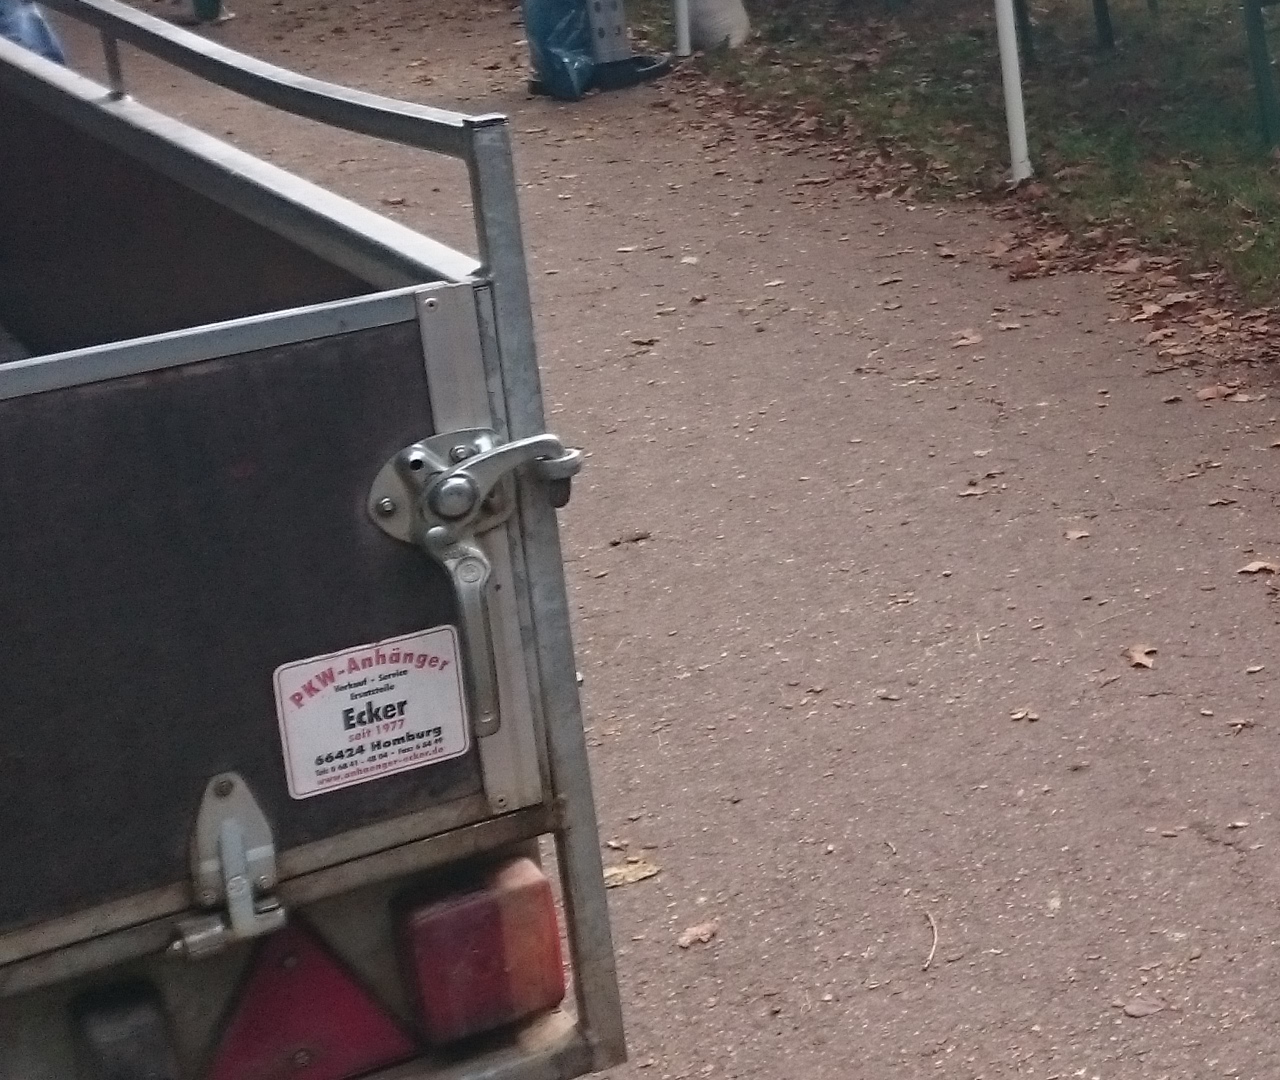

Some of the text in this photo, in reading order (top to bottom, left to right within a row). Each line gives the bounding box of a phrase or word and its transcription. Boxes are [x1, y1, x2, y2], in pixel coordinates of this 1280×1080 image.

[289, 647, 450, 709] PKW-Anhänger
[378, 669, 409, 682] Service
[342, 700, 408, 731] Ecker
[348, 718, 406, 743] seit 1977
[315, 726, 442, 766] 66424 Homburg
